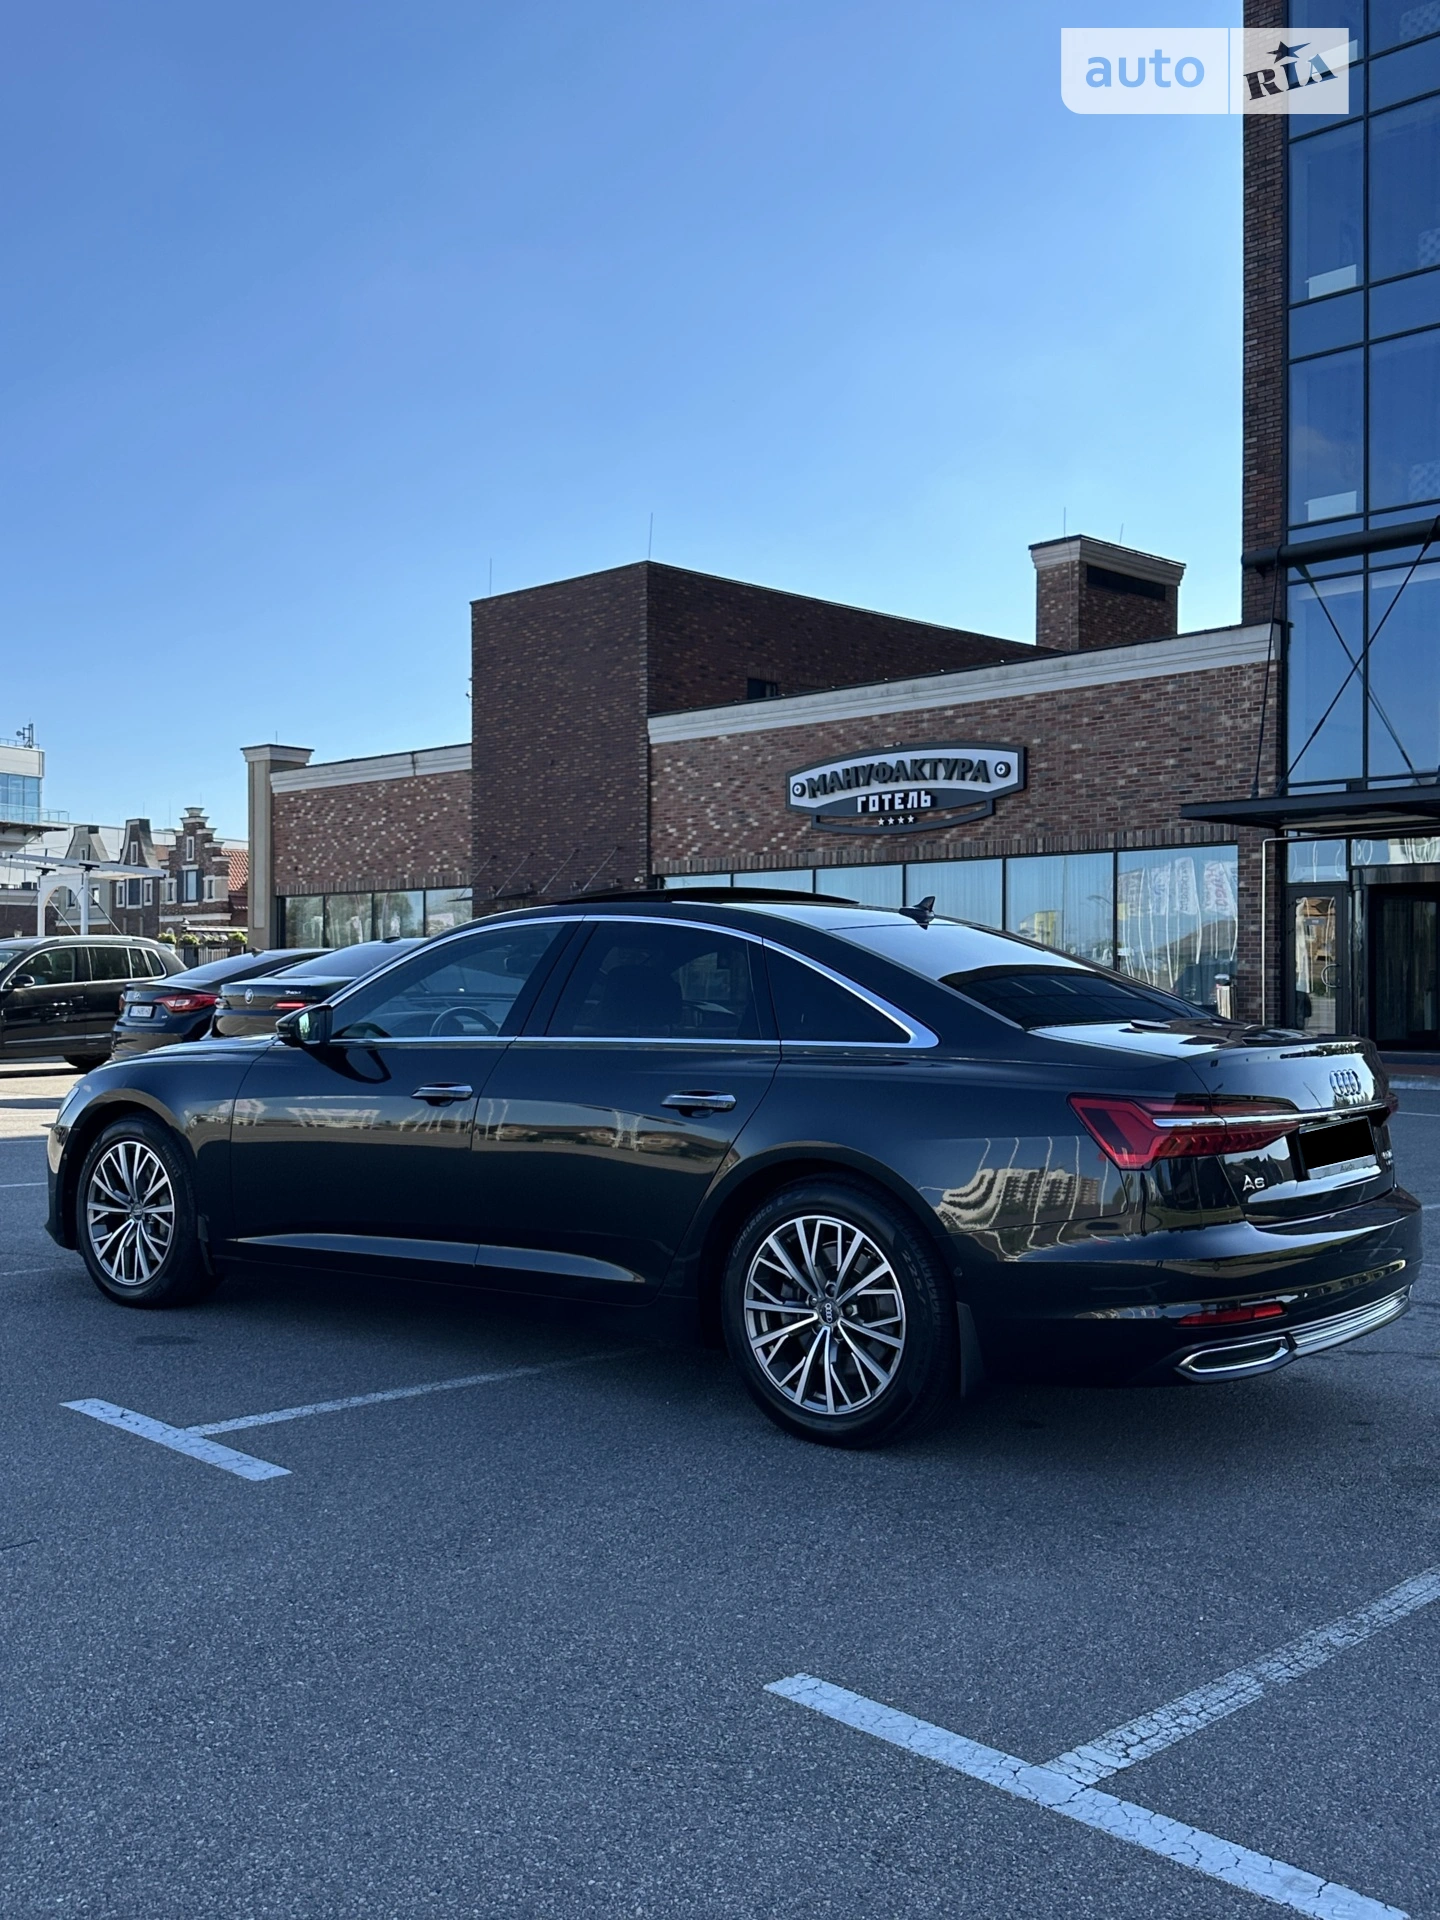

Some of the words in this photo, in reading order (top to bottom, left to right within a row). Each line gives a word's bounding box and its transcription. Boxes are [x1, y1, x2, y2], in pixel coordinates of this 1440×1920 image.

[805, 757, 991, 799] МАНУФАКТУРА
[857, 790, 932, 813] ГОТЕЛЬ
[1242, 1174, 1266, 1192] A6
